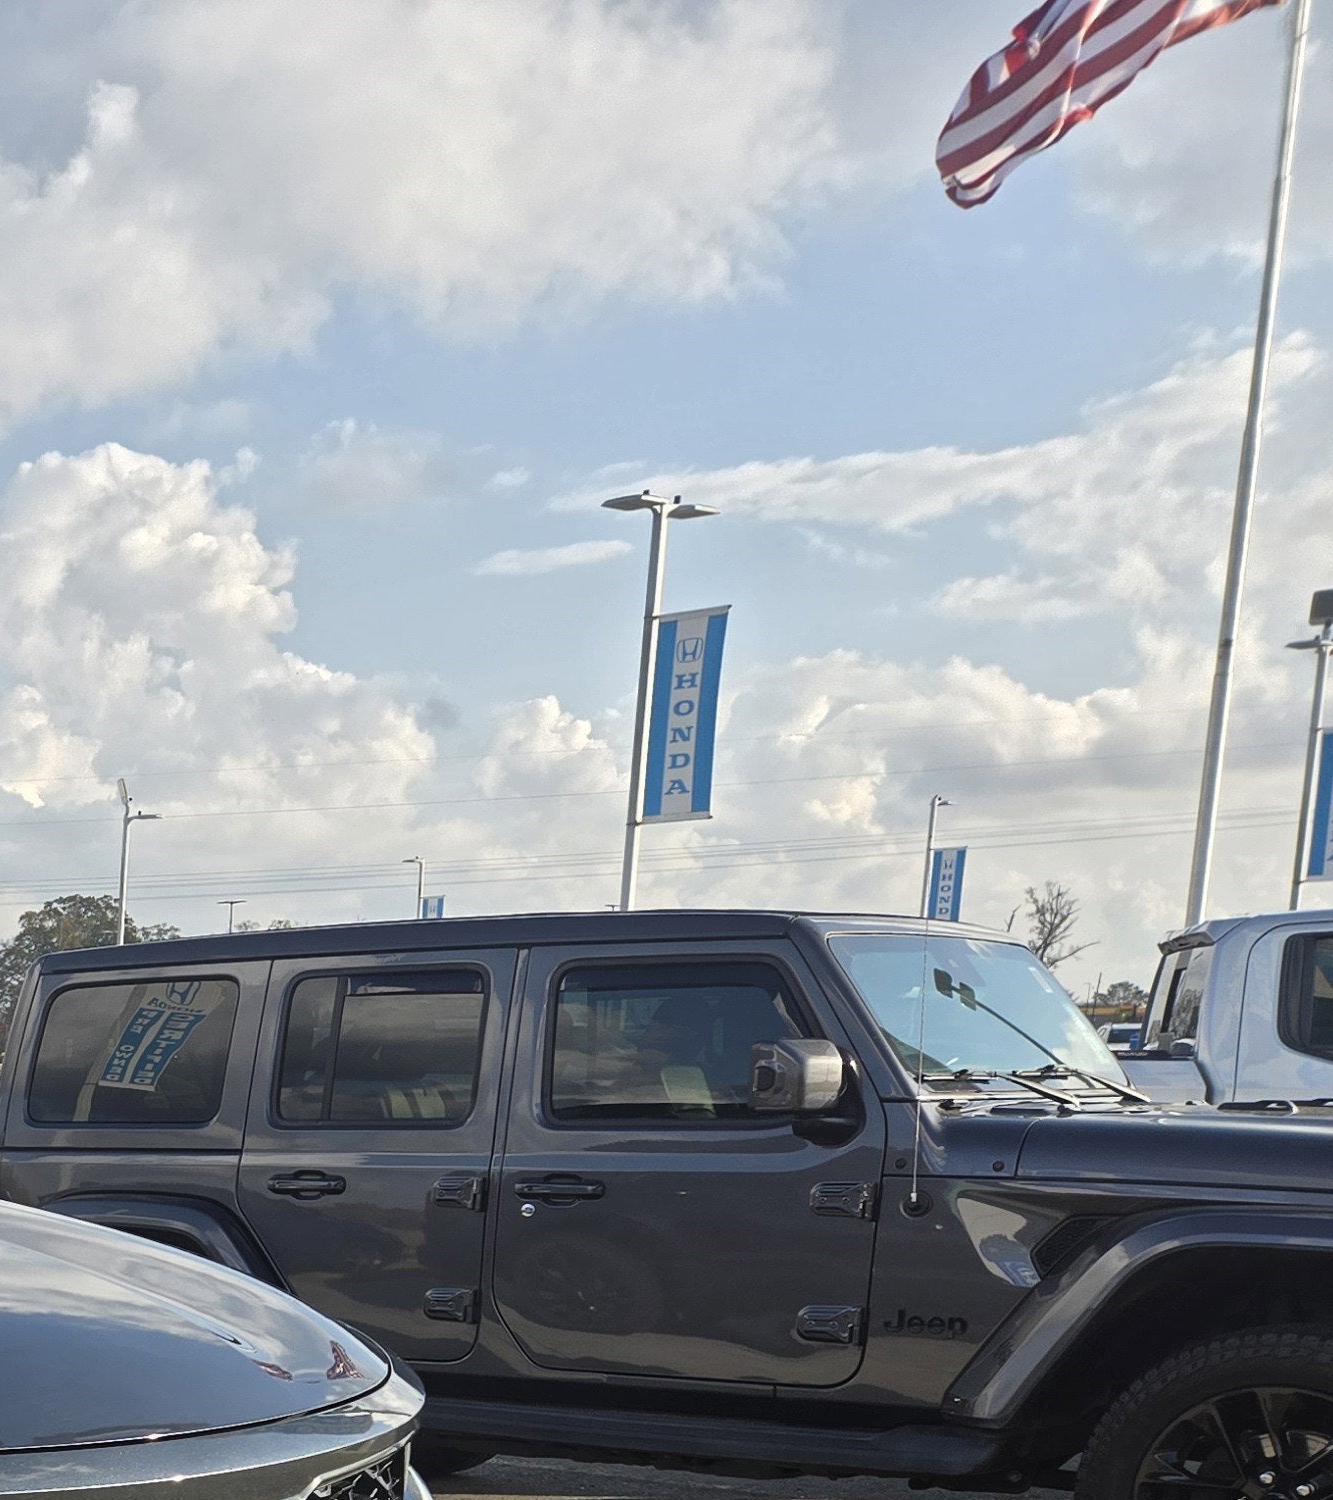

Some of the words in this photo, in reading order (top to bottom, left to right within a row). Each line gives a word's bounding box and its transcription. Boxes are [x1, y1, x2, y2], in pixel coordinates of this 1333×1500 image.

[664, 672, 699, 795] HONDA
[939, 873, 953, 915] HOND
[883, 1309, 968, 1339] Jeep
